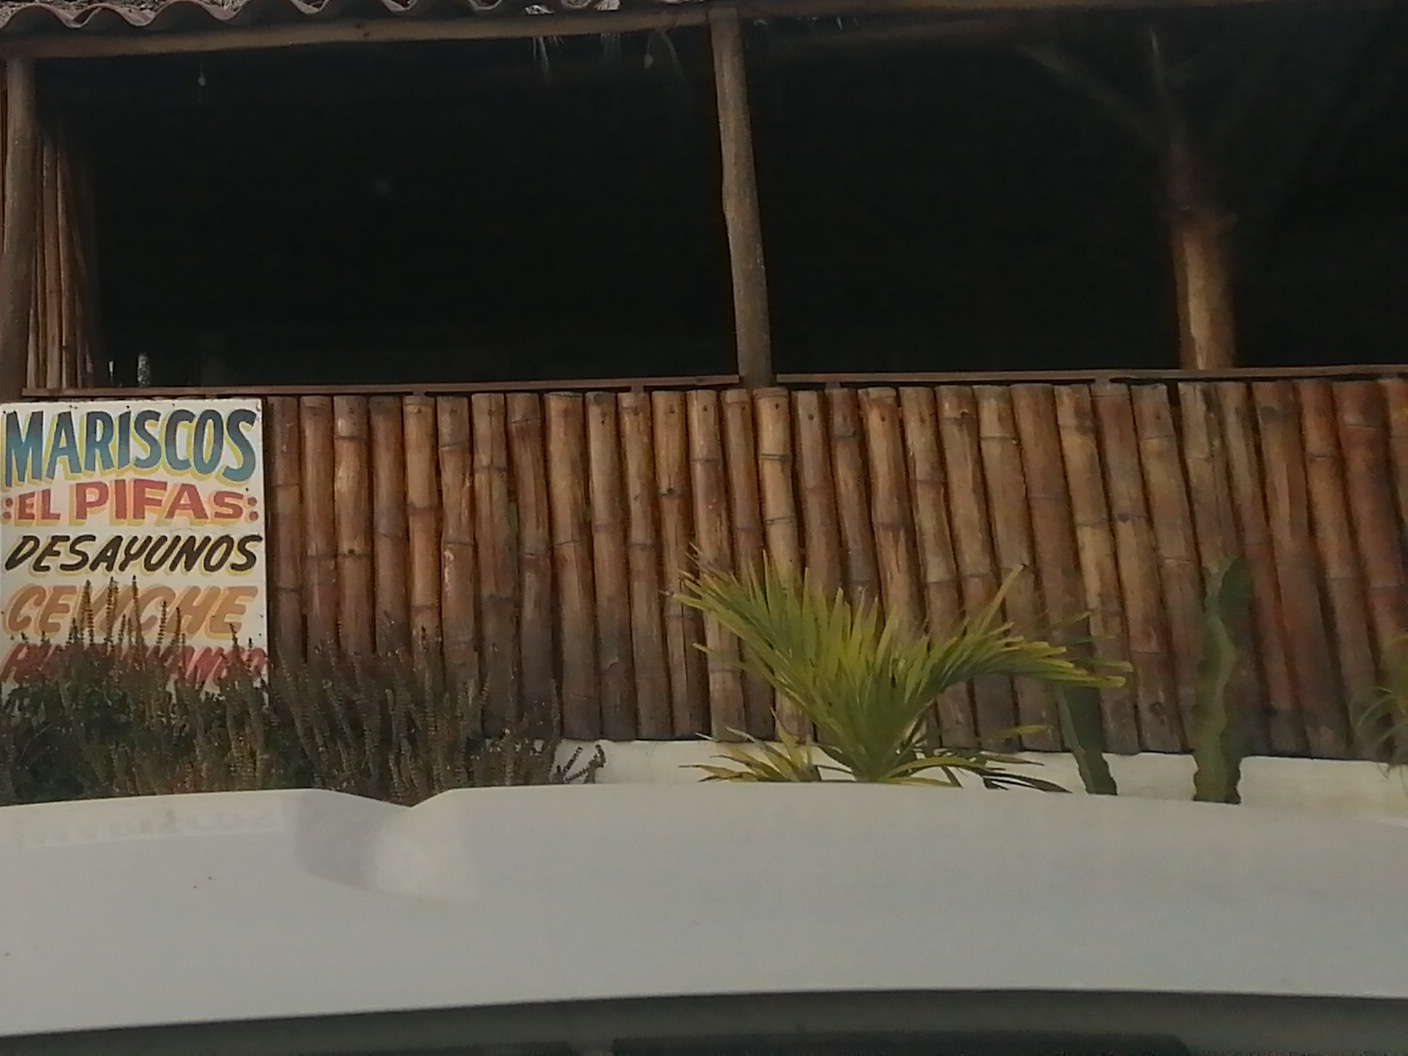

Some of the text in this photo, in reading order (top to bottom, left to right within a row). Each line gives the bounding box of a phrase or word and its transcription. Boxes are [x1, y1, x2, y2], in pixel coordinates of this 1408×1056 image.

[2, 408, 259, 488] MARISCOS
[3, 534, 263, 576] DESAYUNOS
[3, 583, 260, 639] CEVICHE
